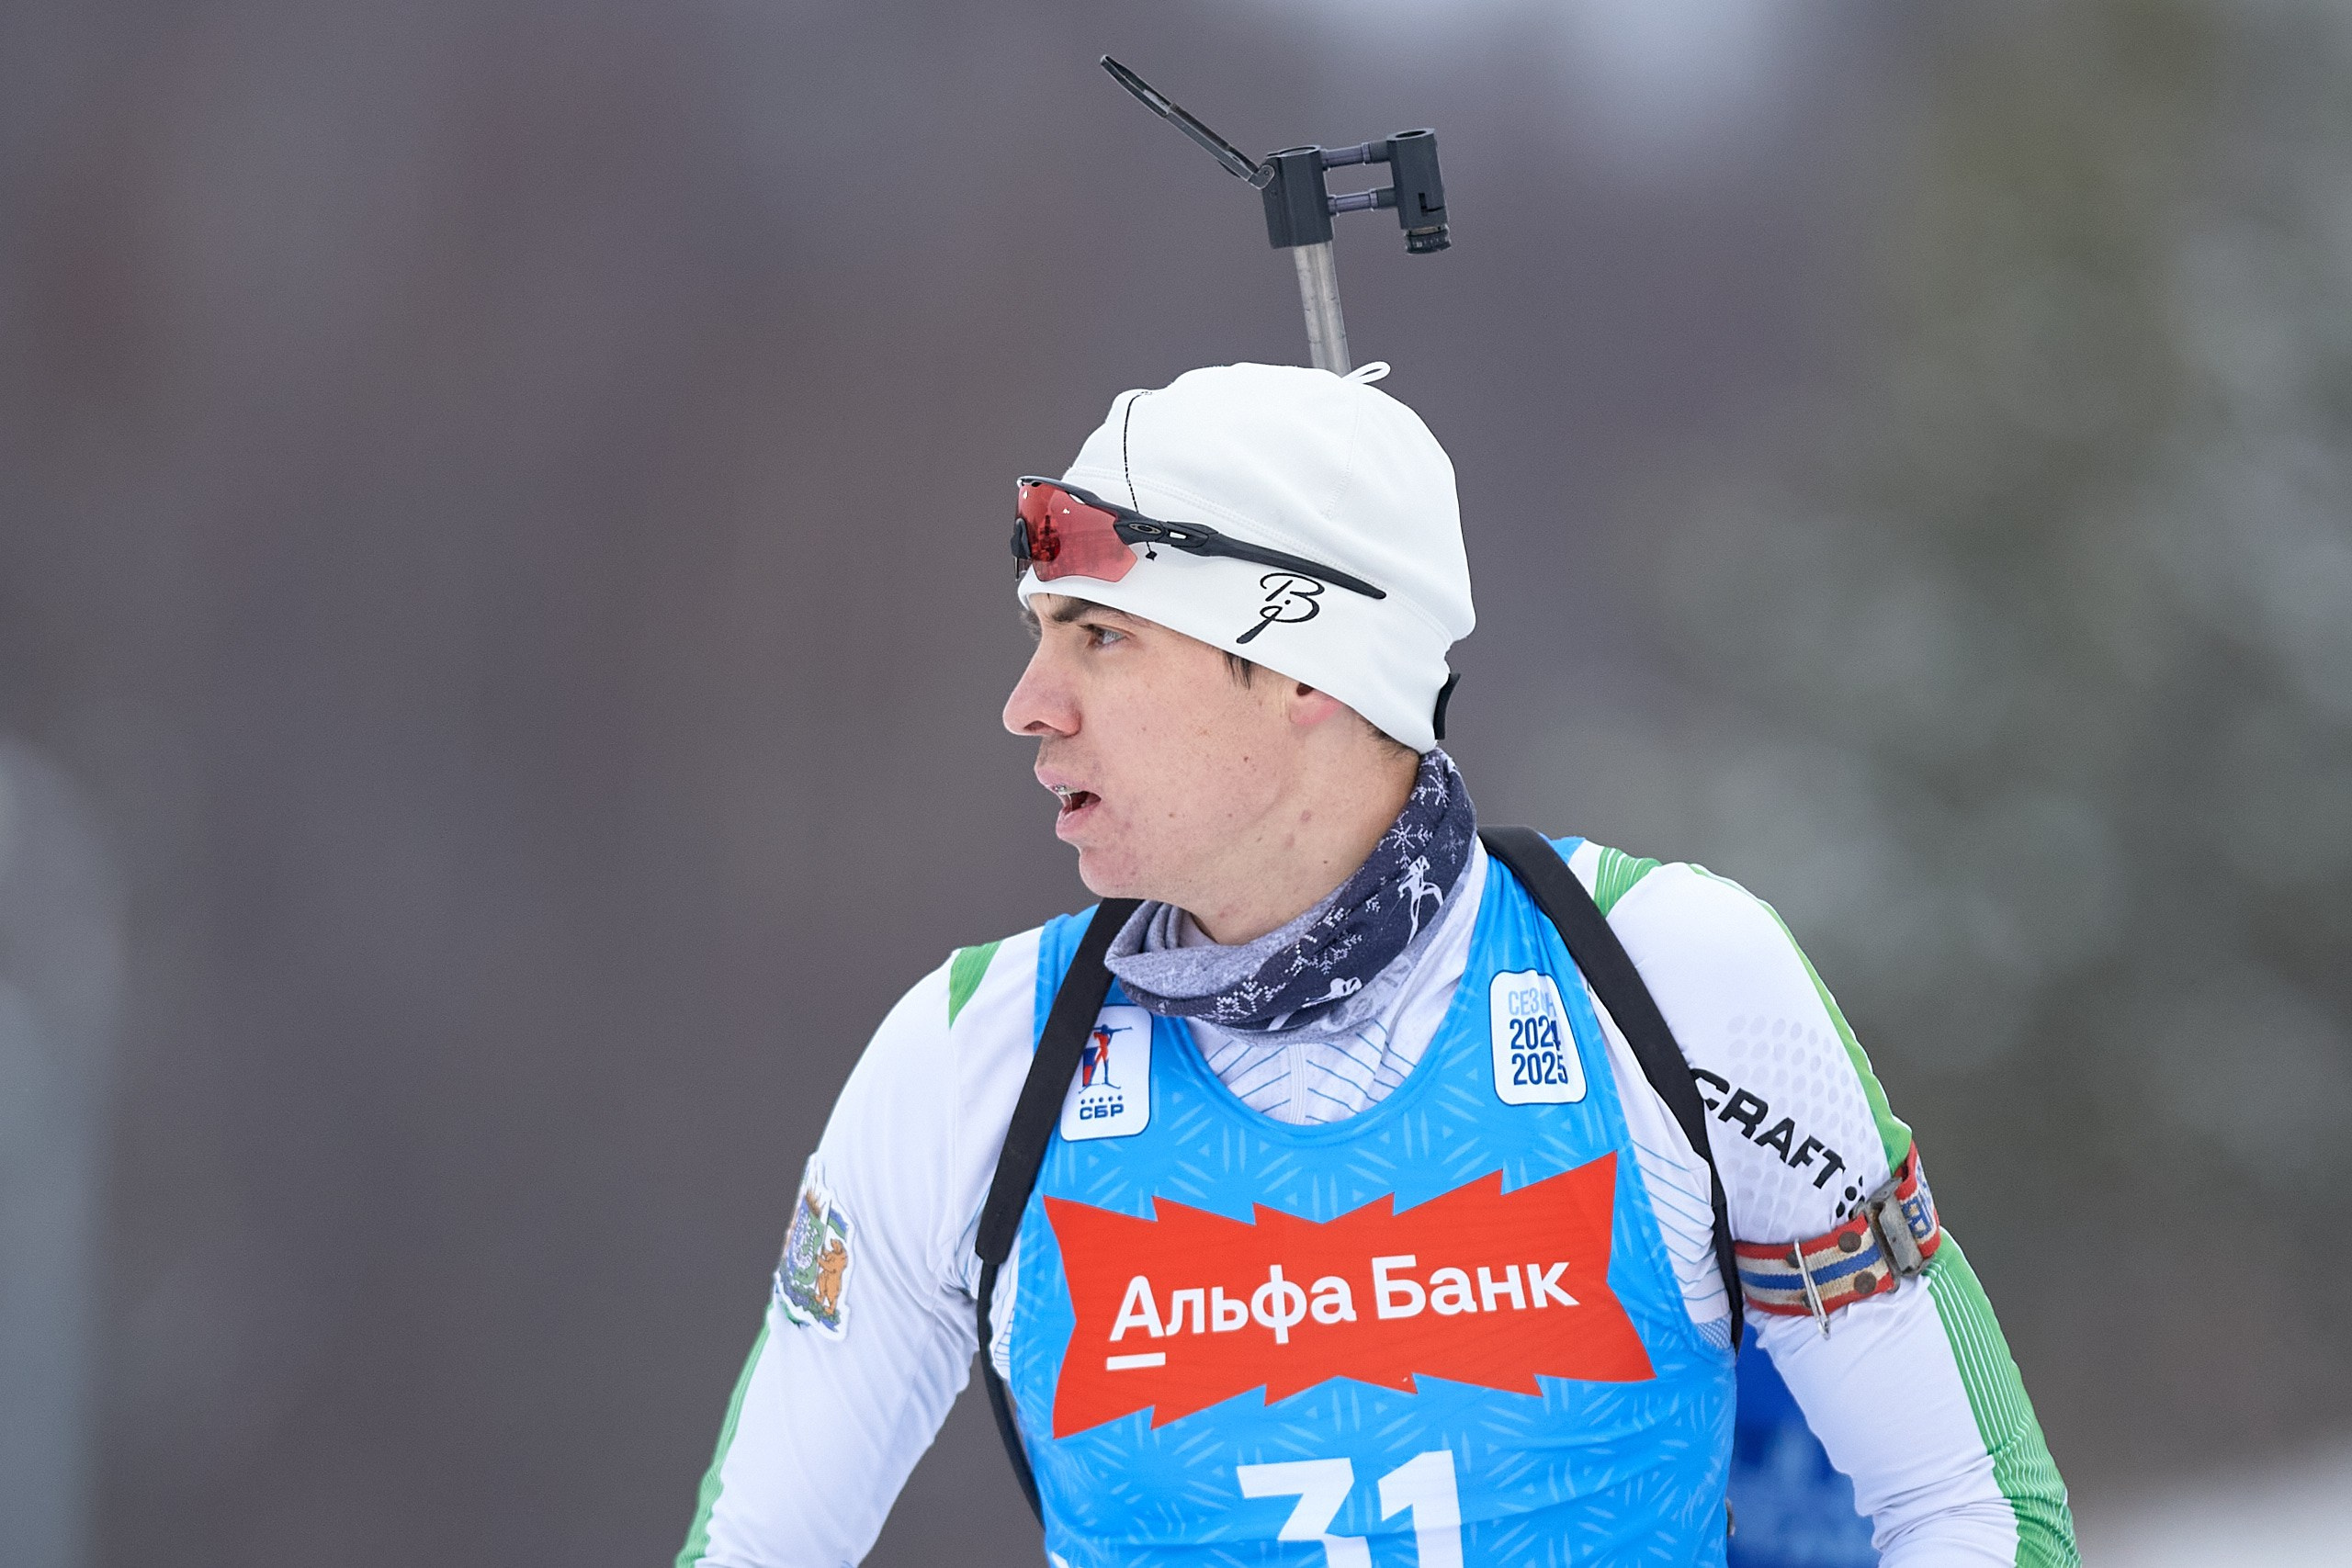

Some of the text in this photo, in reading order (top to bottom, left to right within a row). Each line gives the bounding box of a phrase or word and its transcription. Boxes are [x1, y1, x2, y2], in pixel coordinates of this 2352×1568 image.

[1080, 1103, 1125, 1121] СБР
[1511, 1051, 1568, 1086] 2025
[1690, 1067, 1846, 1190] CRAFT
[1109, 1254, 1580, 1345] Альфа Банк
[1237, 1450, 1464, 1568] 31
